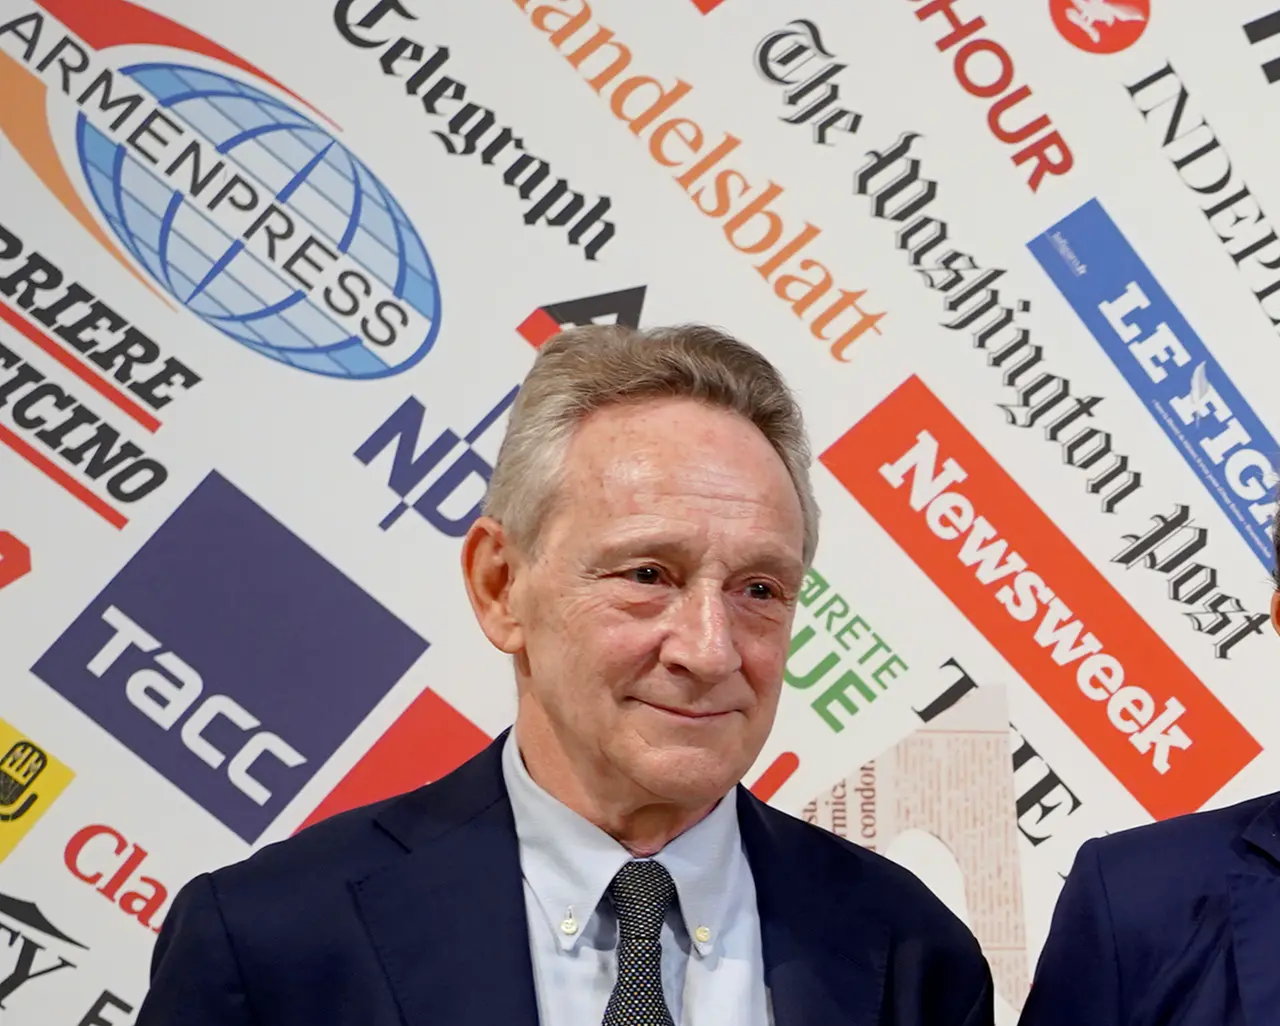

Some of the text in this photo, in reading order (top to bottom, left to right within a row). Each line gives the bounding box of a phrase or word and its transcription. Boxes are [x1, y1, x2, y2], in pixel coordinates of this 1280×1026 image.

[1, 11, 409, 348] ARMENPRESS
[333, 0, 617, 262] Telegraph
[513, 0, 889, 363] andelsblatt
[915, 0, 1075, 193] HOUR
[0, 340, 168, 503] ICINO
[753, 18, 863, 146] The
[852, 131, 1143, 515] Washington
[1111, 504, 1272, 659] Post
[1098, 281, 1191, 384] LE
[814, 592, 910, 690] RETE
[878, 430, 1193, 775] Newsweek
